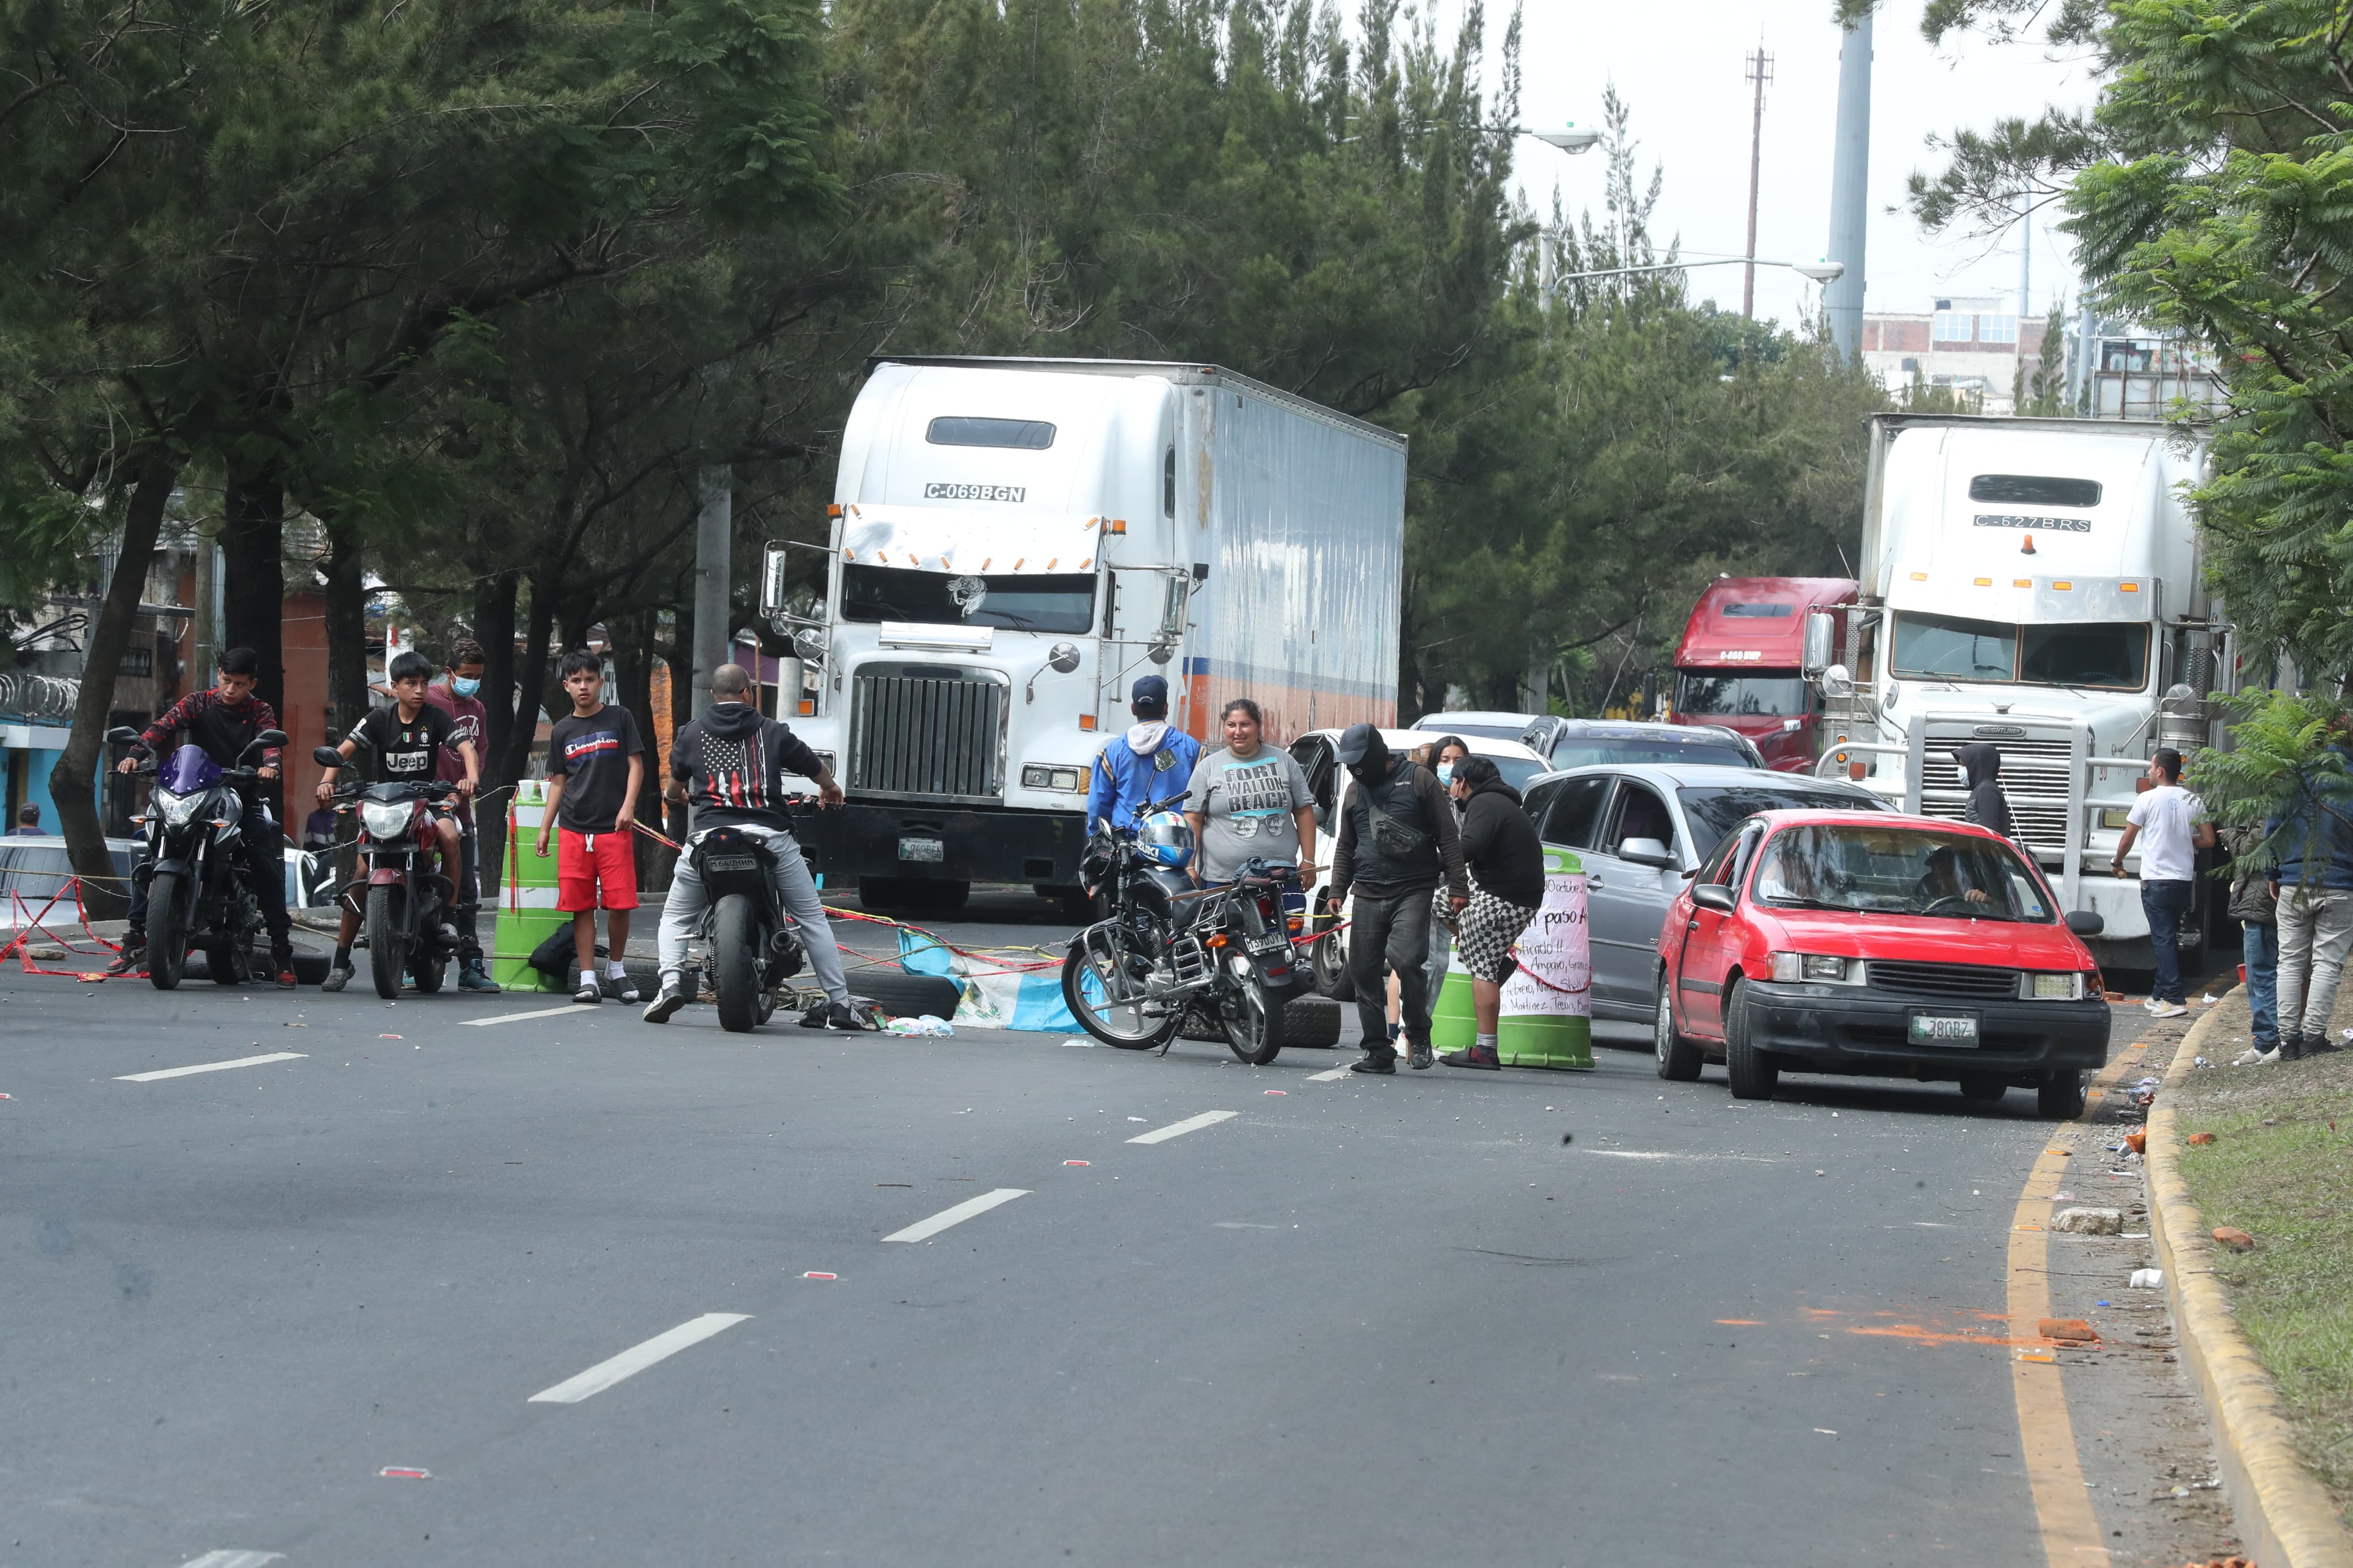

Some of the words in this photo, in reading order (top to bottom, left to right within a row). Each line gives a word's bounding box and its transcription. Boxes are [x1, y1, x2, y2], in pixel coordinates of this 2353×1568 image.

[926, 483, 1023, 503] C-069BGN
[1976, 516, 2089, 532] C-627BRS
[565, 737, 619, 755] Champion
[387, 754, 427, 770] Jeep
[1224, 762, 1278, 783] FORT
[1227, 777, 1285, 796] WALTON
[1227, 792, 1287, 813] BEACH
[1557, 880, 1580, 895] octubre
[1544, 910, 1577, 936] paso
